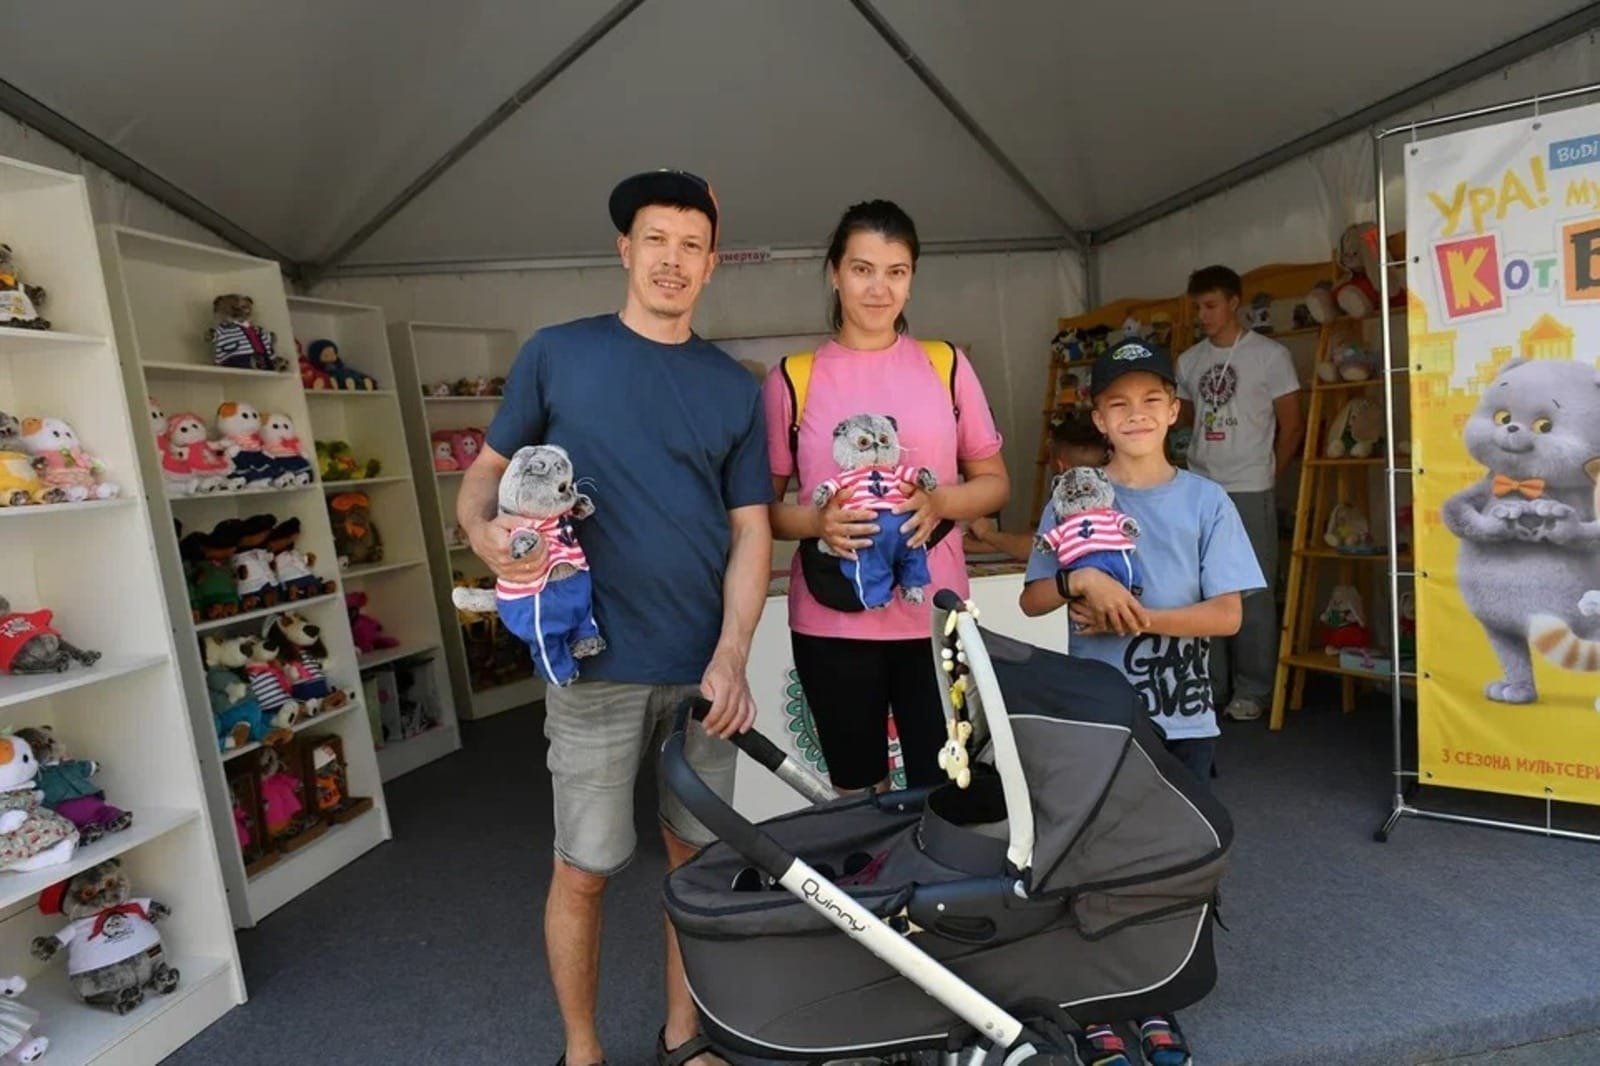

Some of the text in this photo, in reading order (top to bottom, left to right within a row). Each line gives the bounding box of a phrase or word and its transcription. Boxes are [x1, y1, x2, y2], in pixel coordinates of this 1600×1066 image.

[1427, 154, 1551, 236] УРА!
[1441, 749, 1451, 764] 3
[1455, 751, 1512, 771] СЕЗОНА
[801, 878, 866, 932] Quinny
